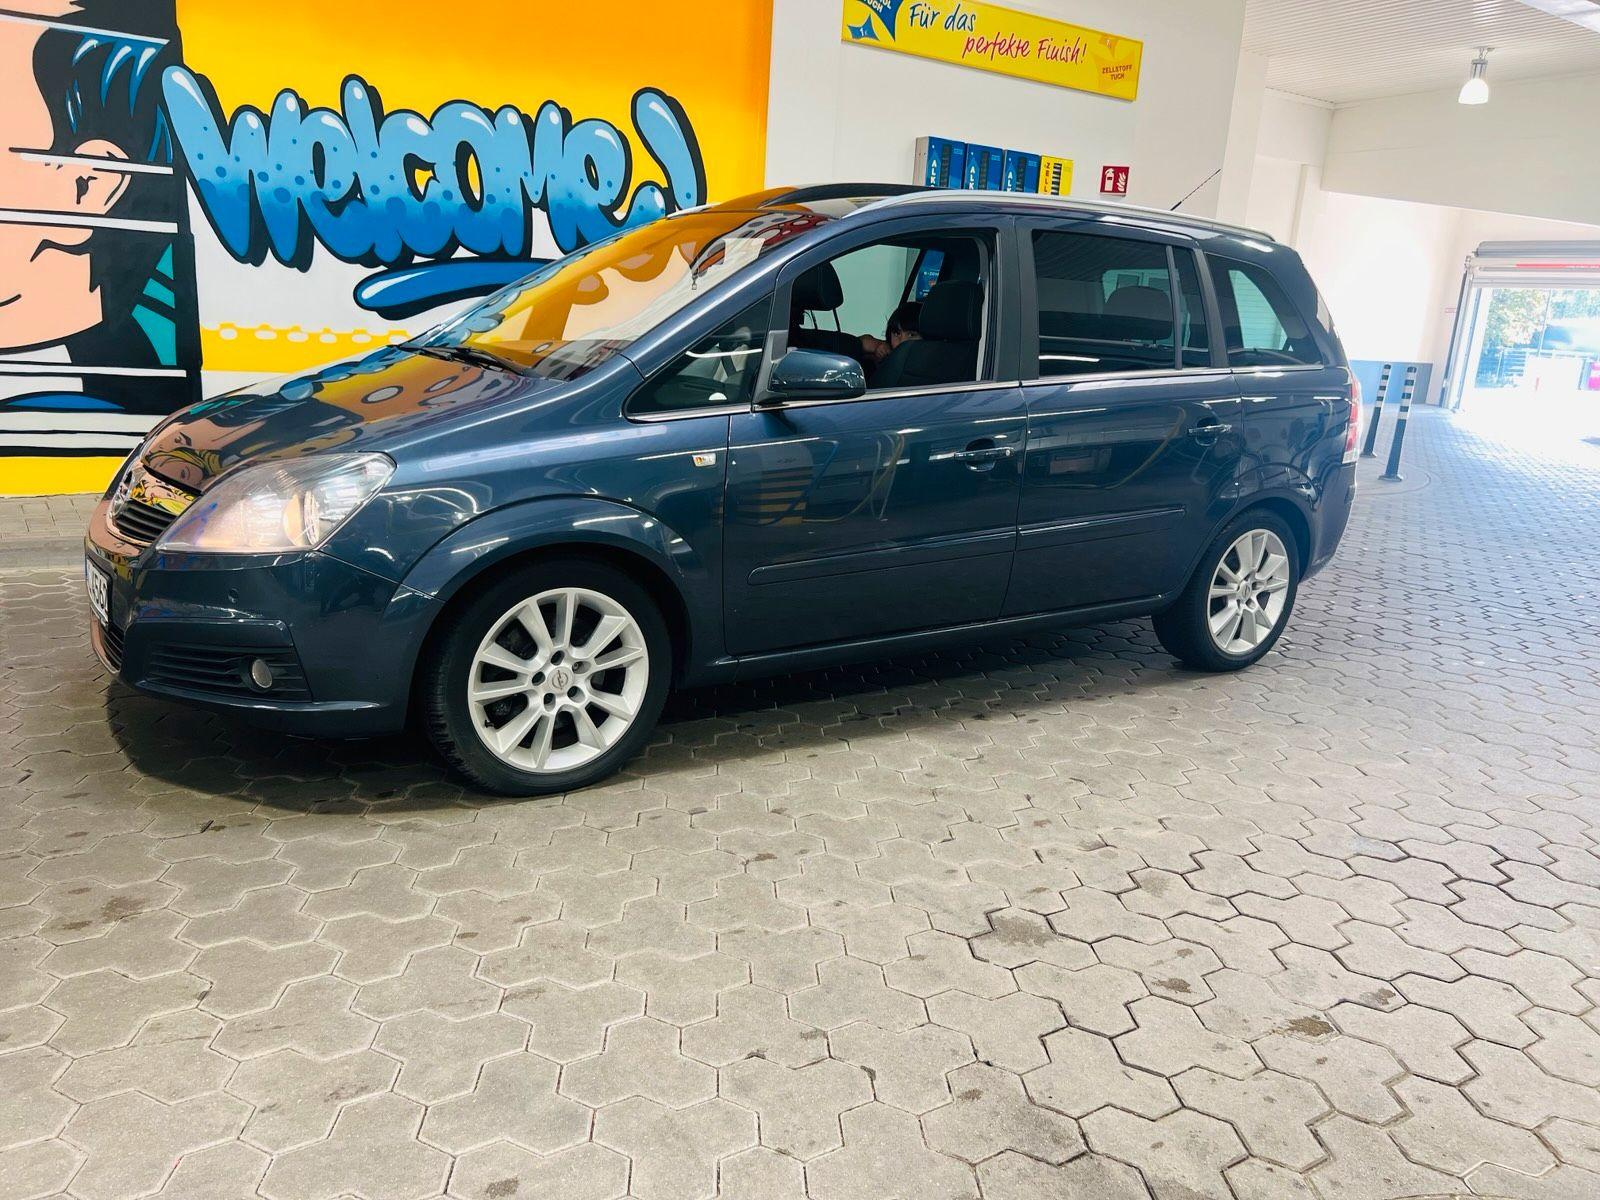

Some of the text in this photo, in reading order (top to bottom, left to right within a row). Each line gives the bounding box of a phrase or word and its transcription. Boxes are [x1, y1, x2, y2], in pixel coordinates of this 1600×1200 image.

[909, 3, 976, 32] Für das
[961, 31, 1087, 66] perfekte Finish!
[1102, 64, 1133, 75] ZELLSTOFF
[1110, 73, 1125, 81] TUCH
